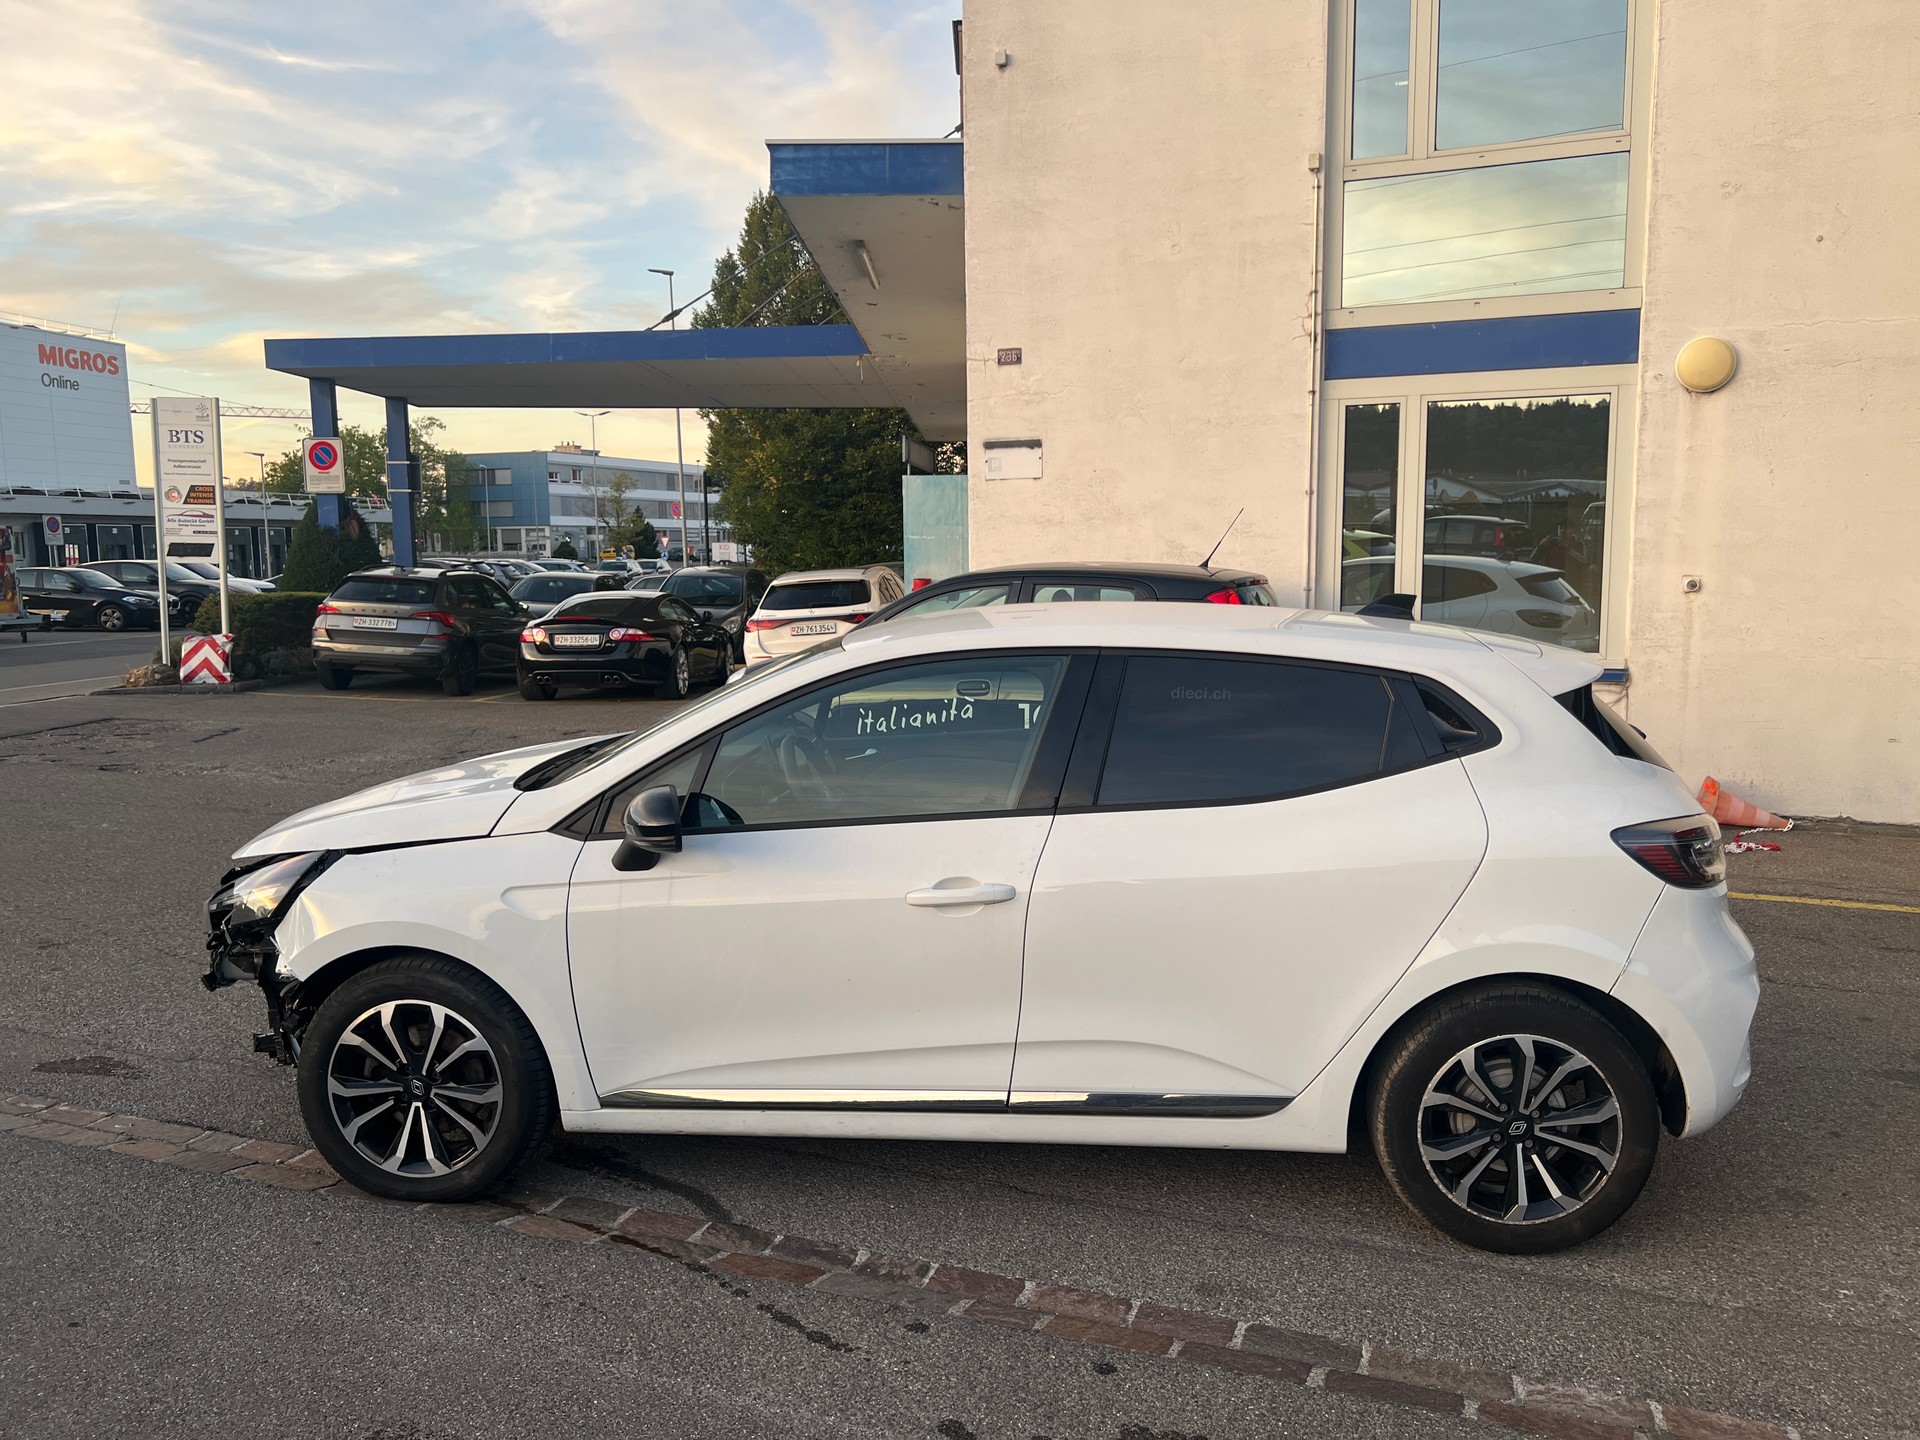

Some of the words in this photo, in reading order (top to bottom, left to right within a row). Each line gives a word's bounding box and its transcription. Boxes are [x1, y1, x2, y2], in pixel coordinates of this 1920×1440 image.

[38, 344, 119, 375] MIGROS
[41, 373, 80, 391] Online
[168, 430, 204, 443] BTS
[1170, 687, 1231, 700] dieci.ch
[858, 696, 974, 734] italianità
